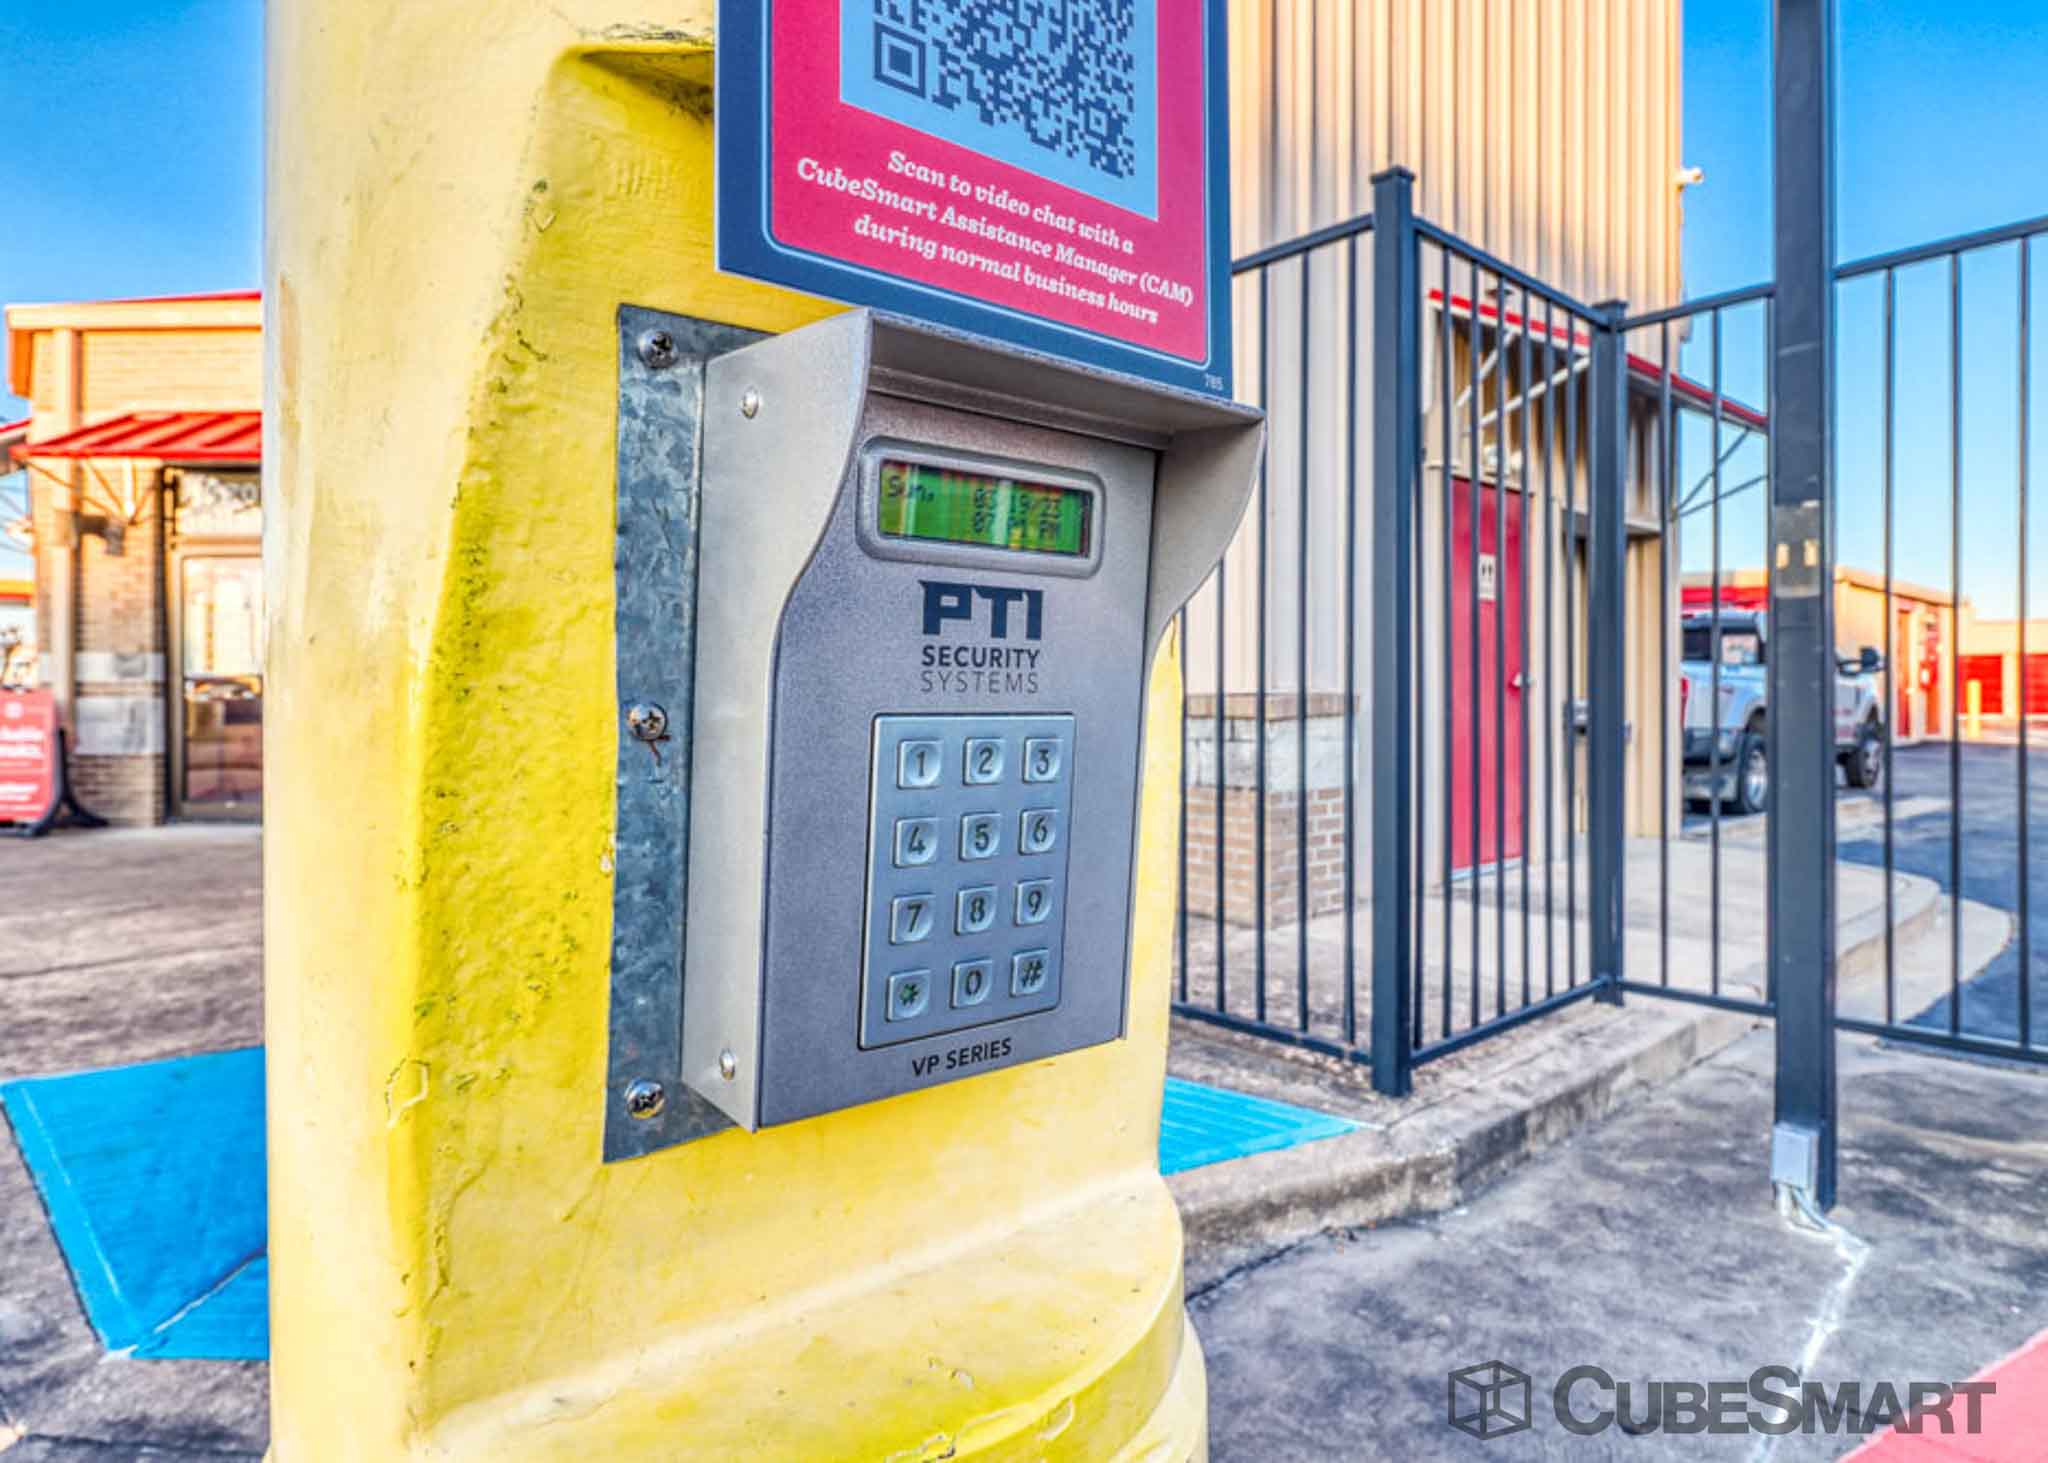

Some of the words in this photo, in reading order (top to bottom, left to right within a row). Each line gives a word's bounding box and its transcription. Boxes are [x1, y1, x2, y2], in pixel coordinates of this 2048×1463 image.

[888, 150, 946, 188] Scan
[950, 174, 971, 196] to
[975, 185, 1030, 216] video
[1033, 206, 1075, 234] chat
[1079, 222, 1120, 251] with
[1122, 240, 1134, 255] a
[797, 157, 938, 221] CubeSmart
[940, 206, 1052, 257] Assistance
[1055, 244, 1138, 285] Manager
[1139, 272, 1194, 307] (CAM)
[854, 214, 938, 260] during
[941, 244, 1021, 282] normal
[1023, 262, 1105, 308] business
[1107, 291, 1159, 324] hours
[918, 579, 1043, 640] PTI
[921, 644, 1040, 669] SECURITY
[920, 670, 1039, 694] SYSTEMS
[916, 751, 926, 778] 1
[977, 747, 993, 775] 2
[1037, 748, 1050, 775] 3
[908, 826, 925, 854] 4
[975, 823, 989, 850] 5
[1033, 816, 1047, 842] 6
[907, 903, 922, 932] 7
[970, 897, 985, 923] 8
[1028, 891, 1041, 916] 9
[965, 970, 981, 996] 0
[911, 1054, 940, 1076] VP
[945, 1036, 1012, 1069] SERIES
